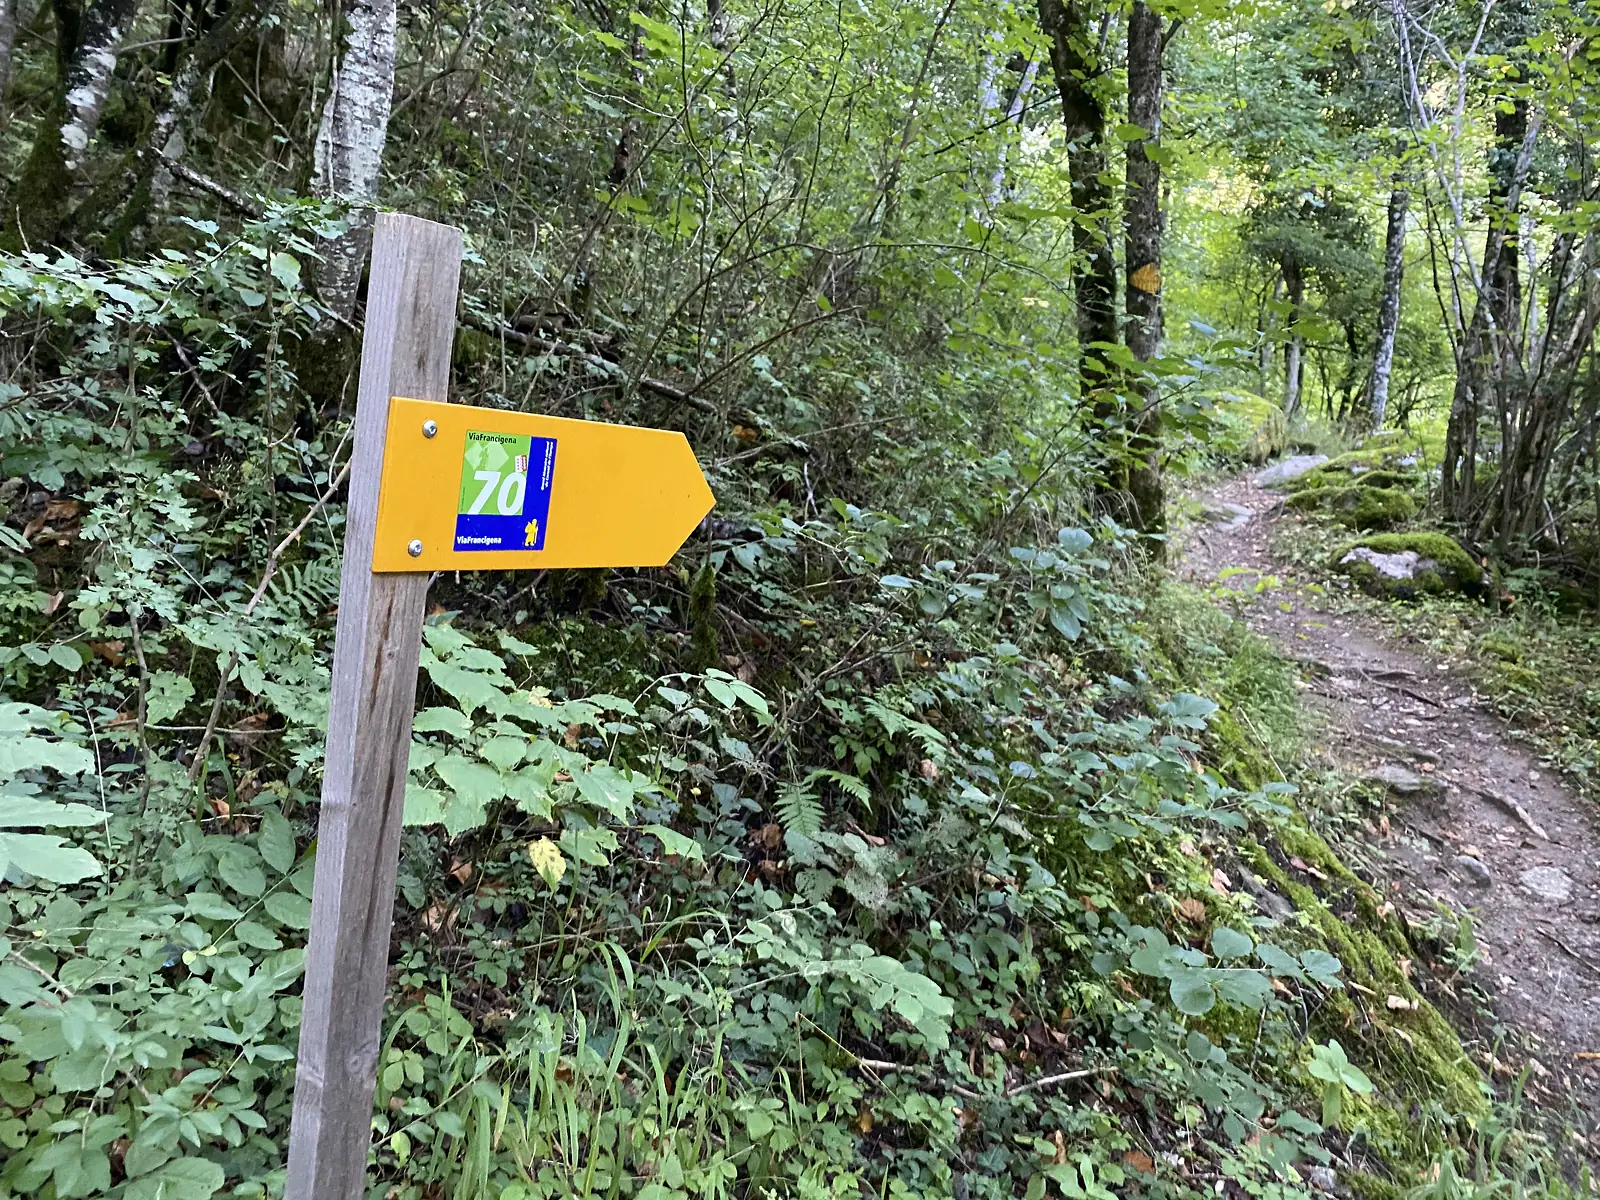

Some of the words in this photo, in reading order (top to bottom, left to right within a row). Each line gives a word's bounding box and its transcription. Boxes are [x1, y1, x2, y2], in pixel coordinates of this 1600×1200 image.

[468, 432, 517, 444] ViaFrancigena
[467, 470, 527, 516] 70
[456, 536, 502, 546] ViaFrancigena
